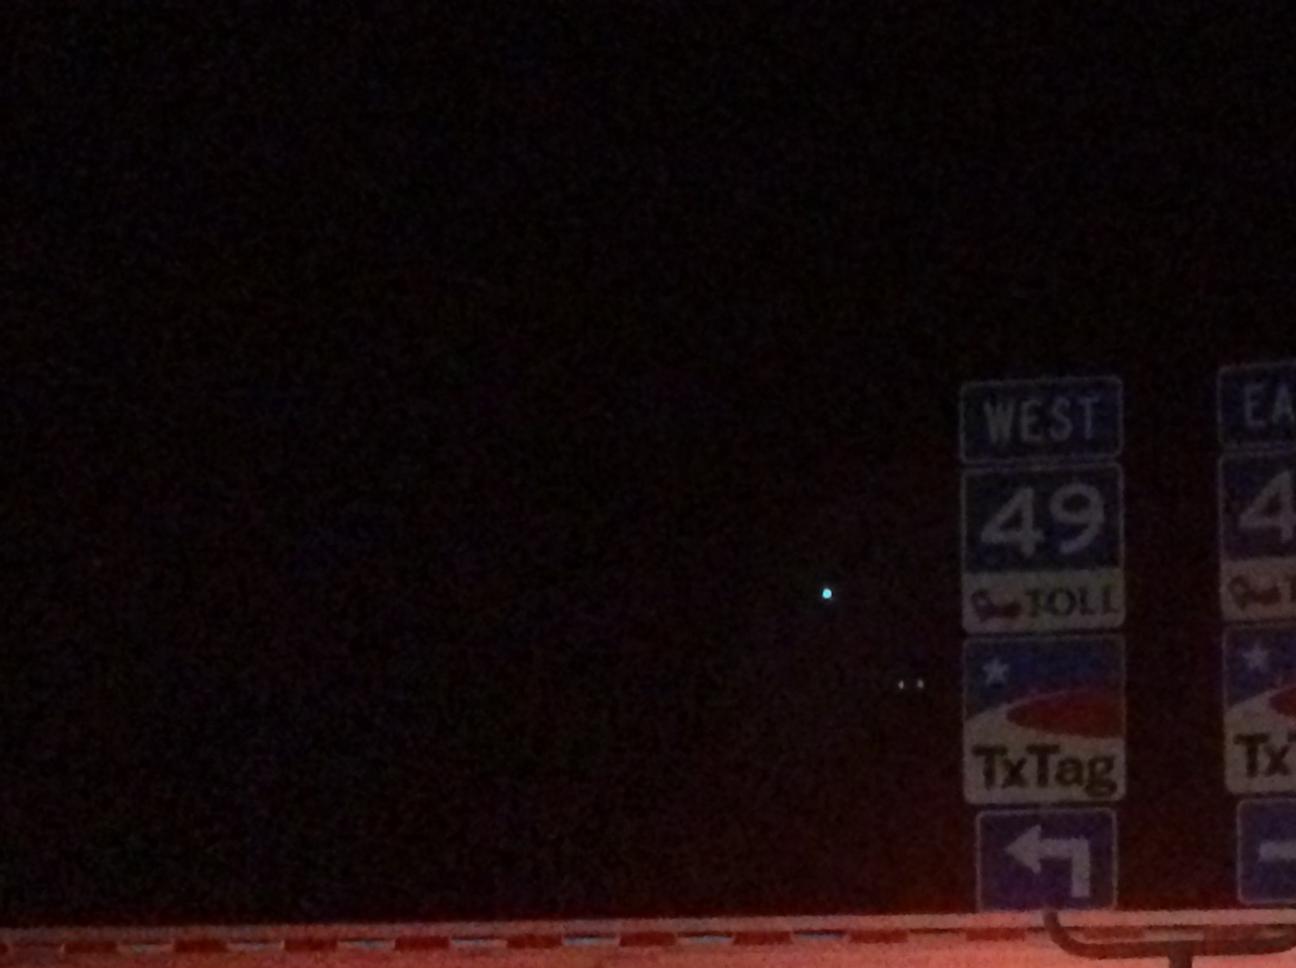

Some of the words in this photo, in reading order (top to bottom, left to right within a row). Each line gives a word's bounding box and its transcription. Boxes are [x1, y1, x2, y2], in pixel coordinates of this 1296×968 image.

[983, 395, 1101, 443] WEST
[980, 483, 1104, 557] 49
[1026, 587, 1120, 617] TOLL
[973, 745, 1117, 795] TxTag
